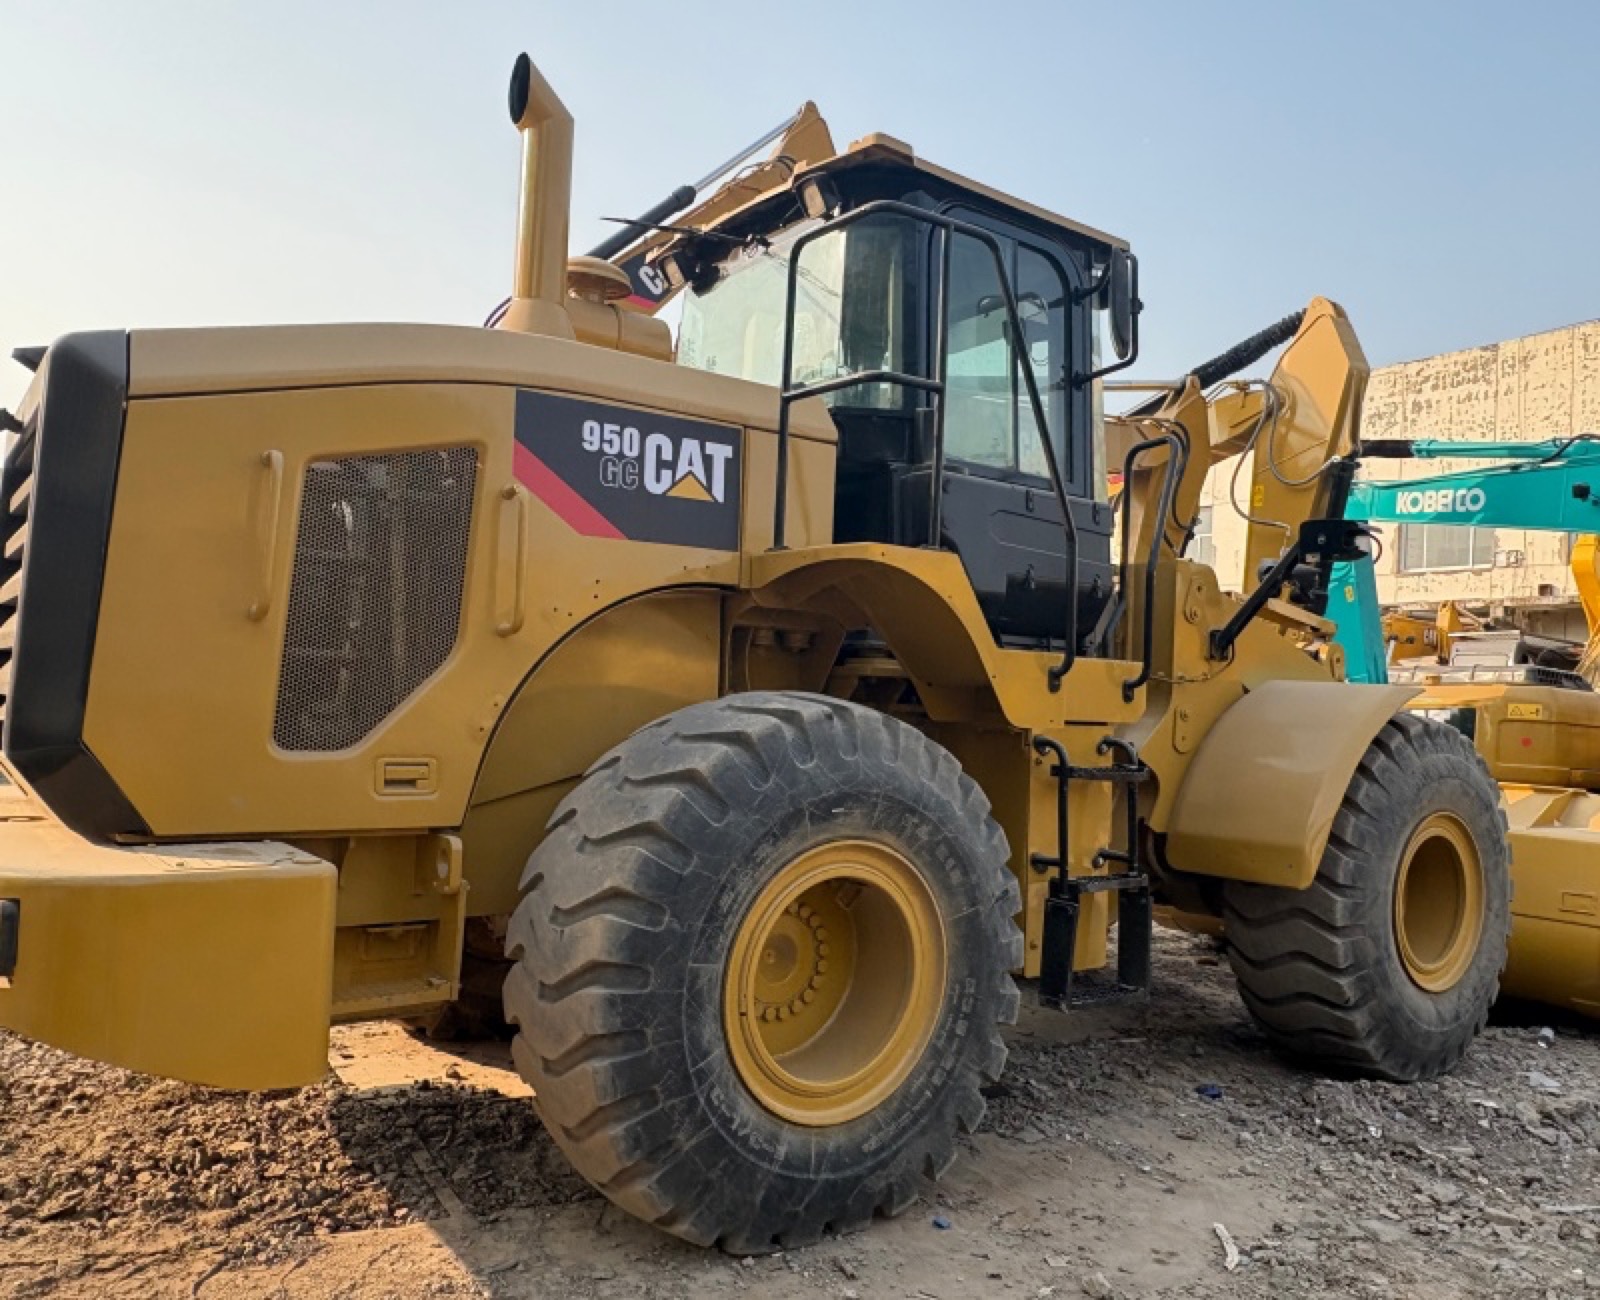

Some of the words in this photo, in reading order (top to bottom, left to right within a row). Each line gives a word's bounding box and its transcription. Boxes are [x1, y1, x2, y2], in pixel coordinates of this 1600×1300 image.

[582, 420, 640, 457] 950
[600, 455, 639, 490] GC
[643, 433, 733, 503] CAT
[1396, 488, 1486, 514] KOBELCO
